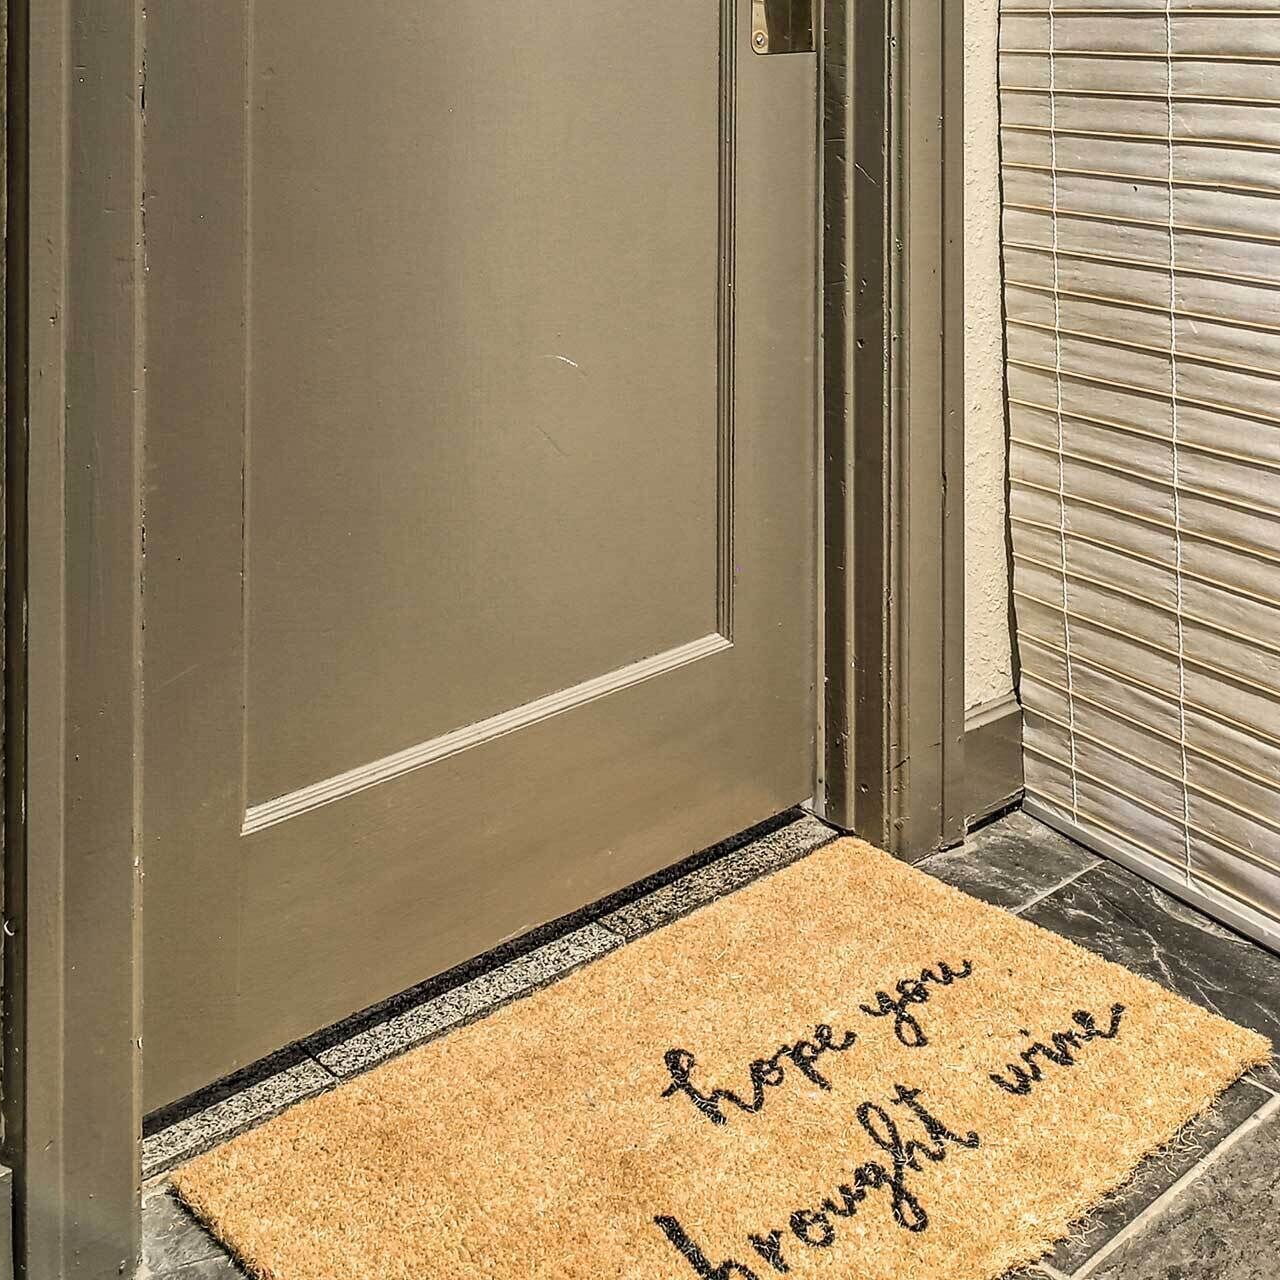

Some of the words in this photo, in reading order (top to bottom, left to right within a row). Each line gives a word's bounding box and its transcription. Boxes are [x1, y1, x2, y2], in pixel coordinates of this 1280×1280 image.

[661, 1024, 857, 1126] hope
[860, 958, 972, 1047] you
[989, 1002, 1125, 1096] wine
